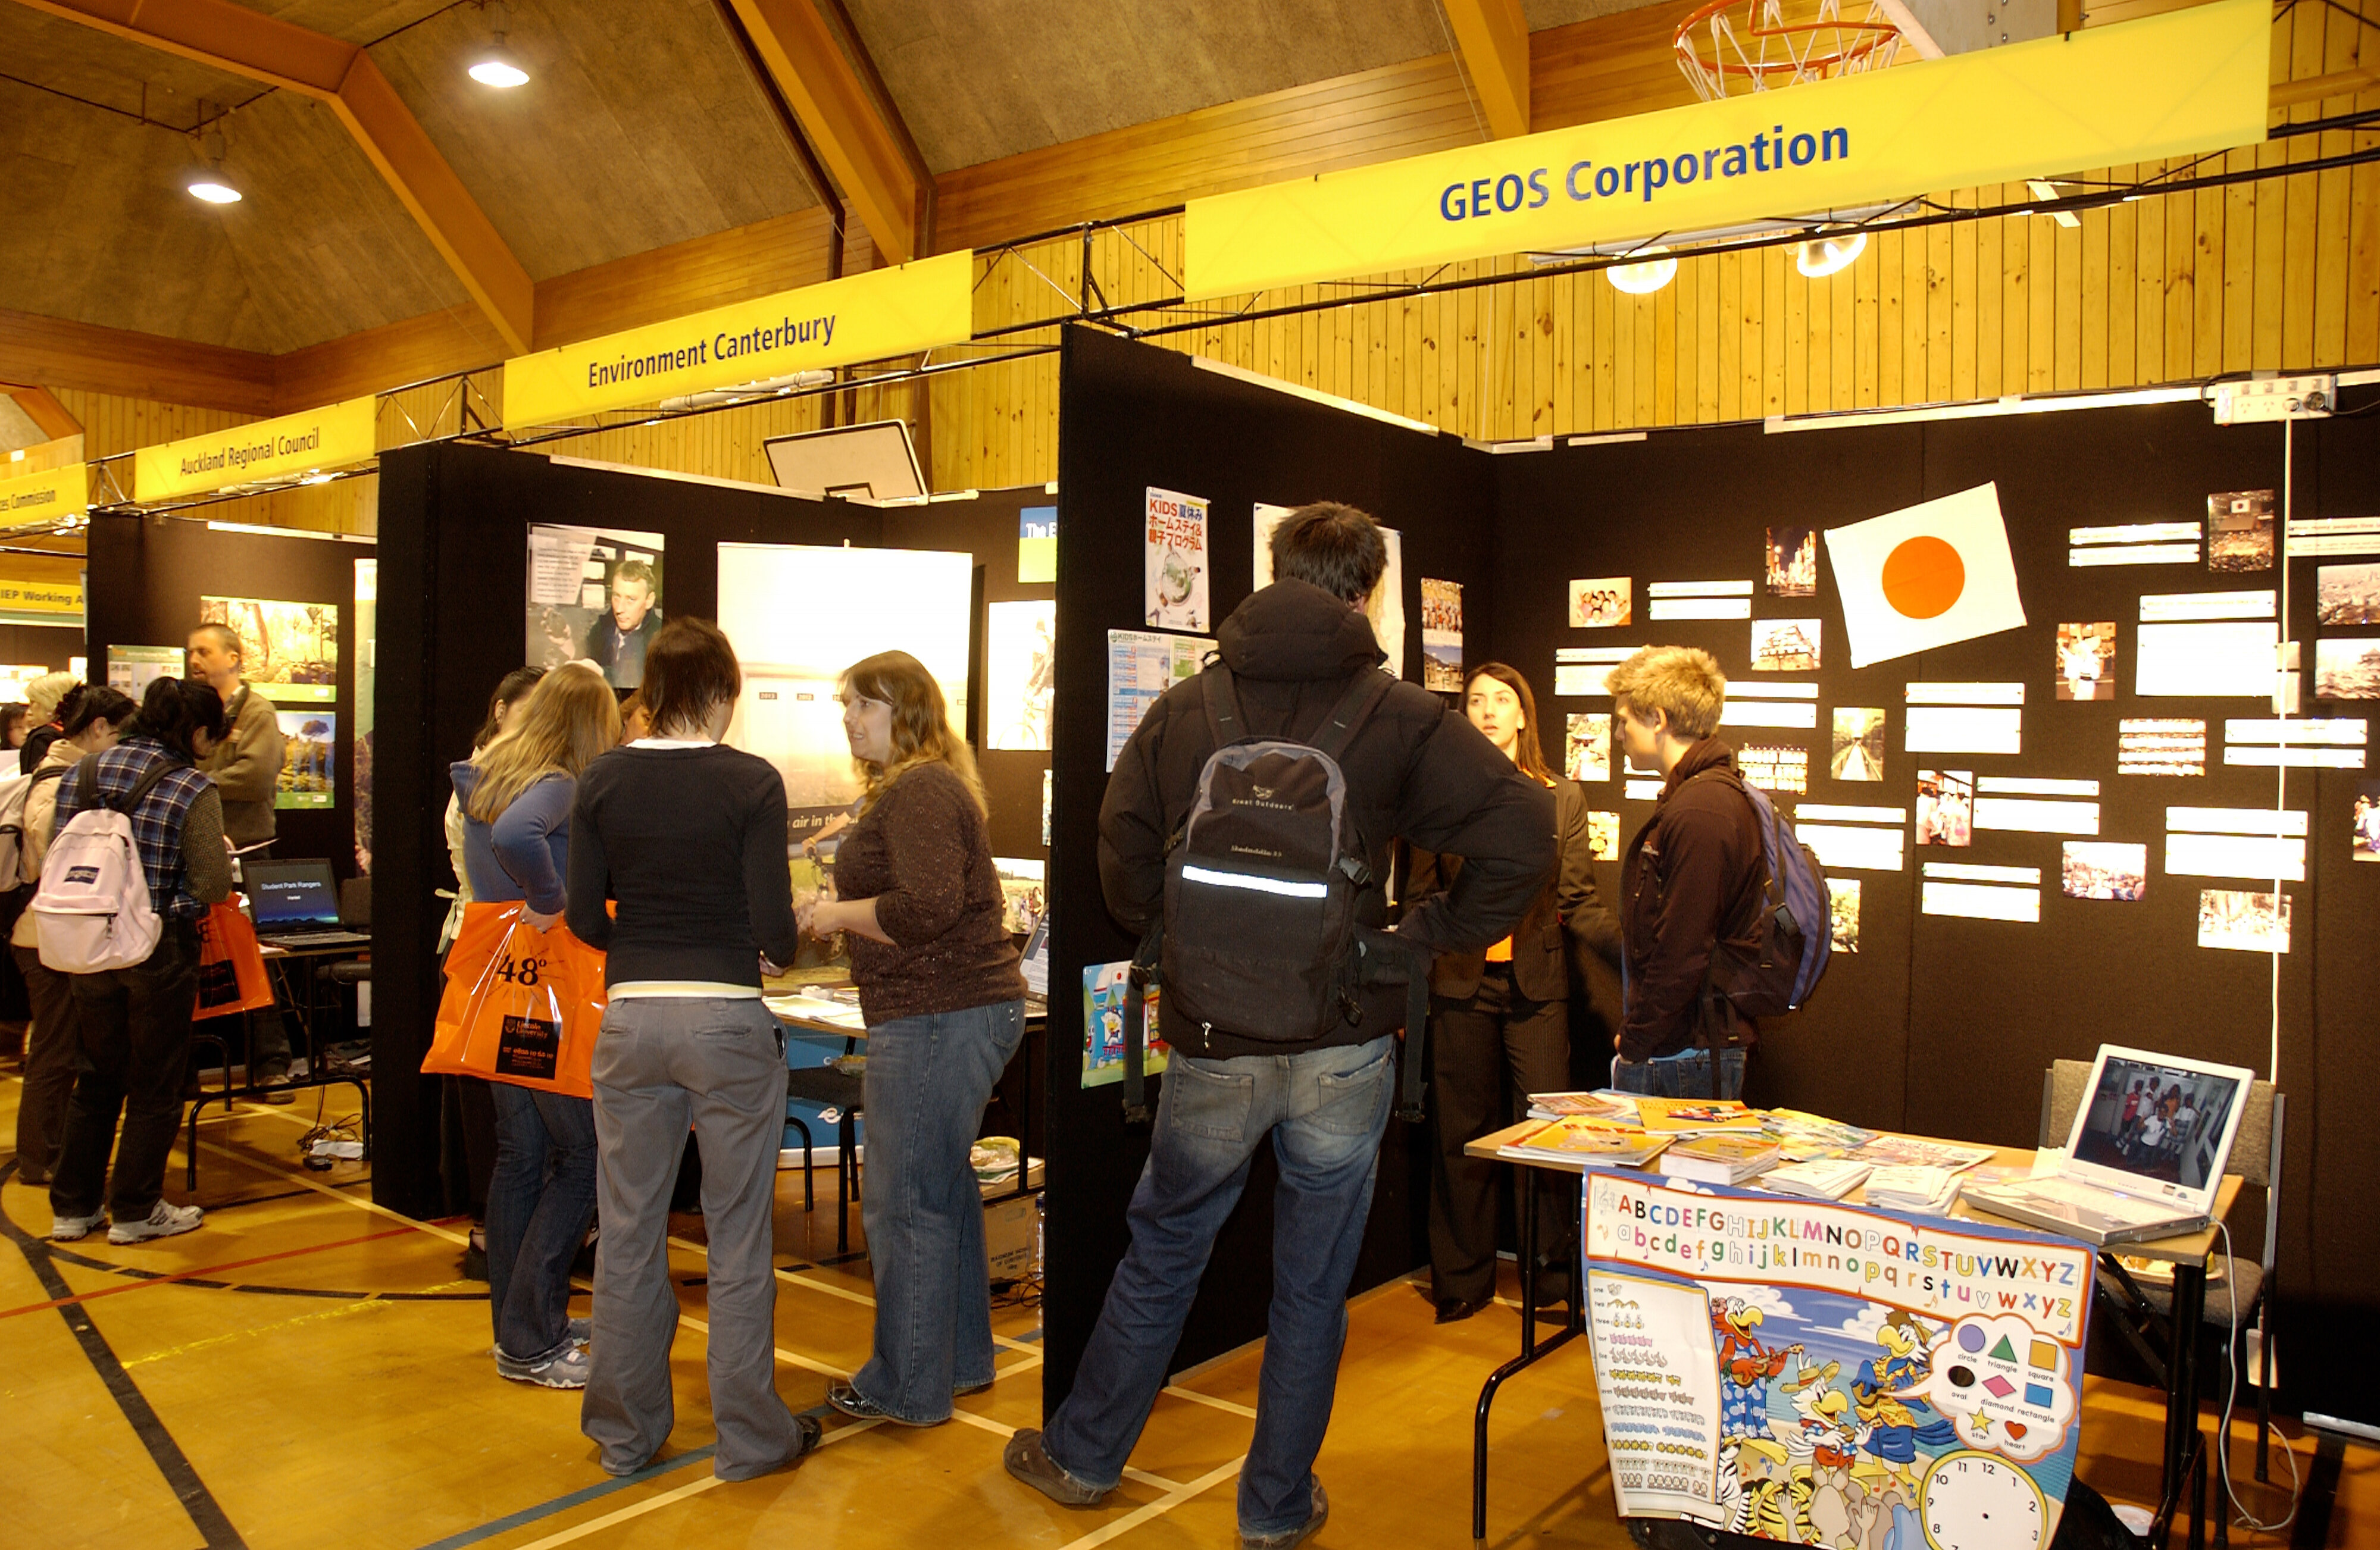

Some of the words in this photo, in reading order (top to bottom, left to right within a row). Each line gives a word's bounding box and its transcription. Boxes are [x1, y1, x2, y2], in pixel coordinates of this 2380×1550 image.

[1440, 168, 1549, 222] GEOS
[1566, 125, 1849, 202] Corporation
[588, 339, 707, 388] Environment
[714, 314, 836, 359] Canterbury
[180, 447, 225, 477] Auckland
[229, 436, 274, 469] Regional
[279, 426, 320, 455] Council
[11, 486, 55, 509] Commission
[1149, 498, 1178, 517] KIDS
[1025, 522, 1046, 538] The
[1, 589, 19, 599] IEP
[23, 590, 72, 606] Working
[792, 815, 809, 829] air
[811, 814, 822, 826] in
[298, 881, 321, 889] Rangers
[1957, 1353, 1977, 1363] circle
[1987, 1360, 2018, 1373] triangle
[2028, 1371, 2054, 1382] square
[1951, 1392, 1968, 1400] oval
[1981, 1398, 2015, 1413] diamond
[2017, 1408, 2054, 1423] rectangle
[1972, 1432, 1987, 1441] star
[2004, 1439, 2025, 1450] heart
[1957, 1461, 1967, 1473] 11
[1982, 1462, 1995, 1475] 12
[1935, 1473, 1949, 1485] 10
[2012, 1476, 2016, 1487] 1
[1927, 1497, 1934, 1507] 9
[2028, 1501, 2036, 1512] 2
[1932, 1523, 1941, 1534] 8
[2031, 1530, 2038, 1541] 3
